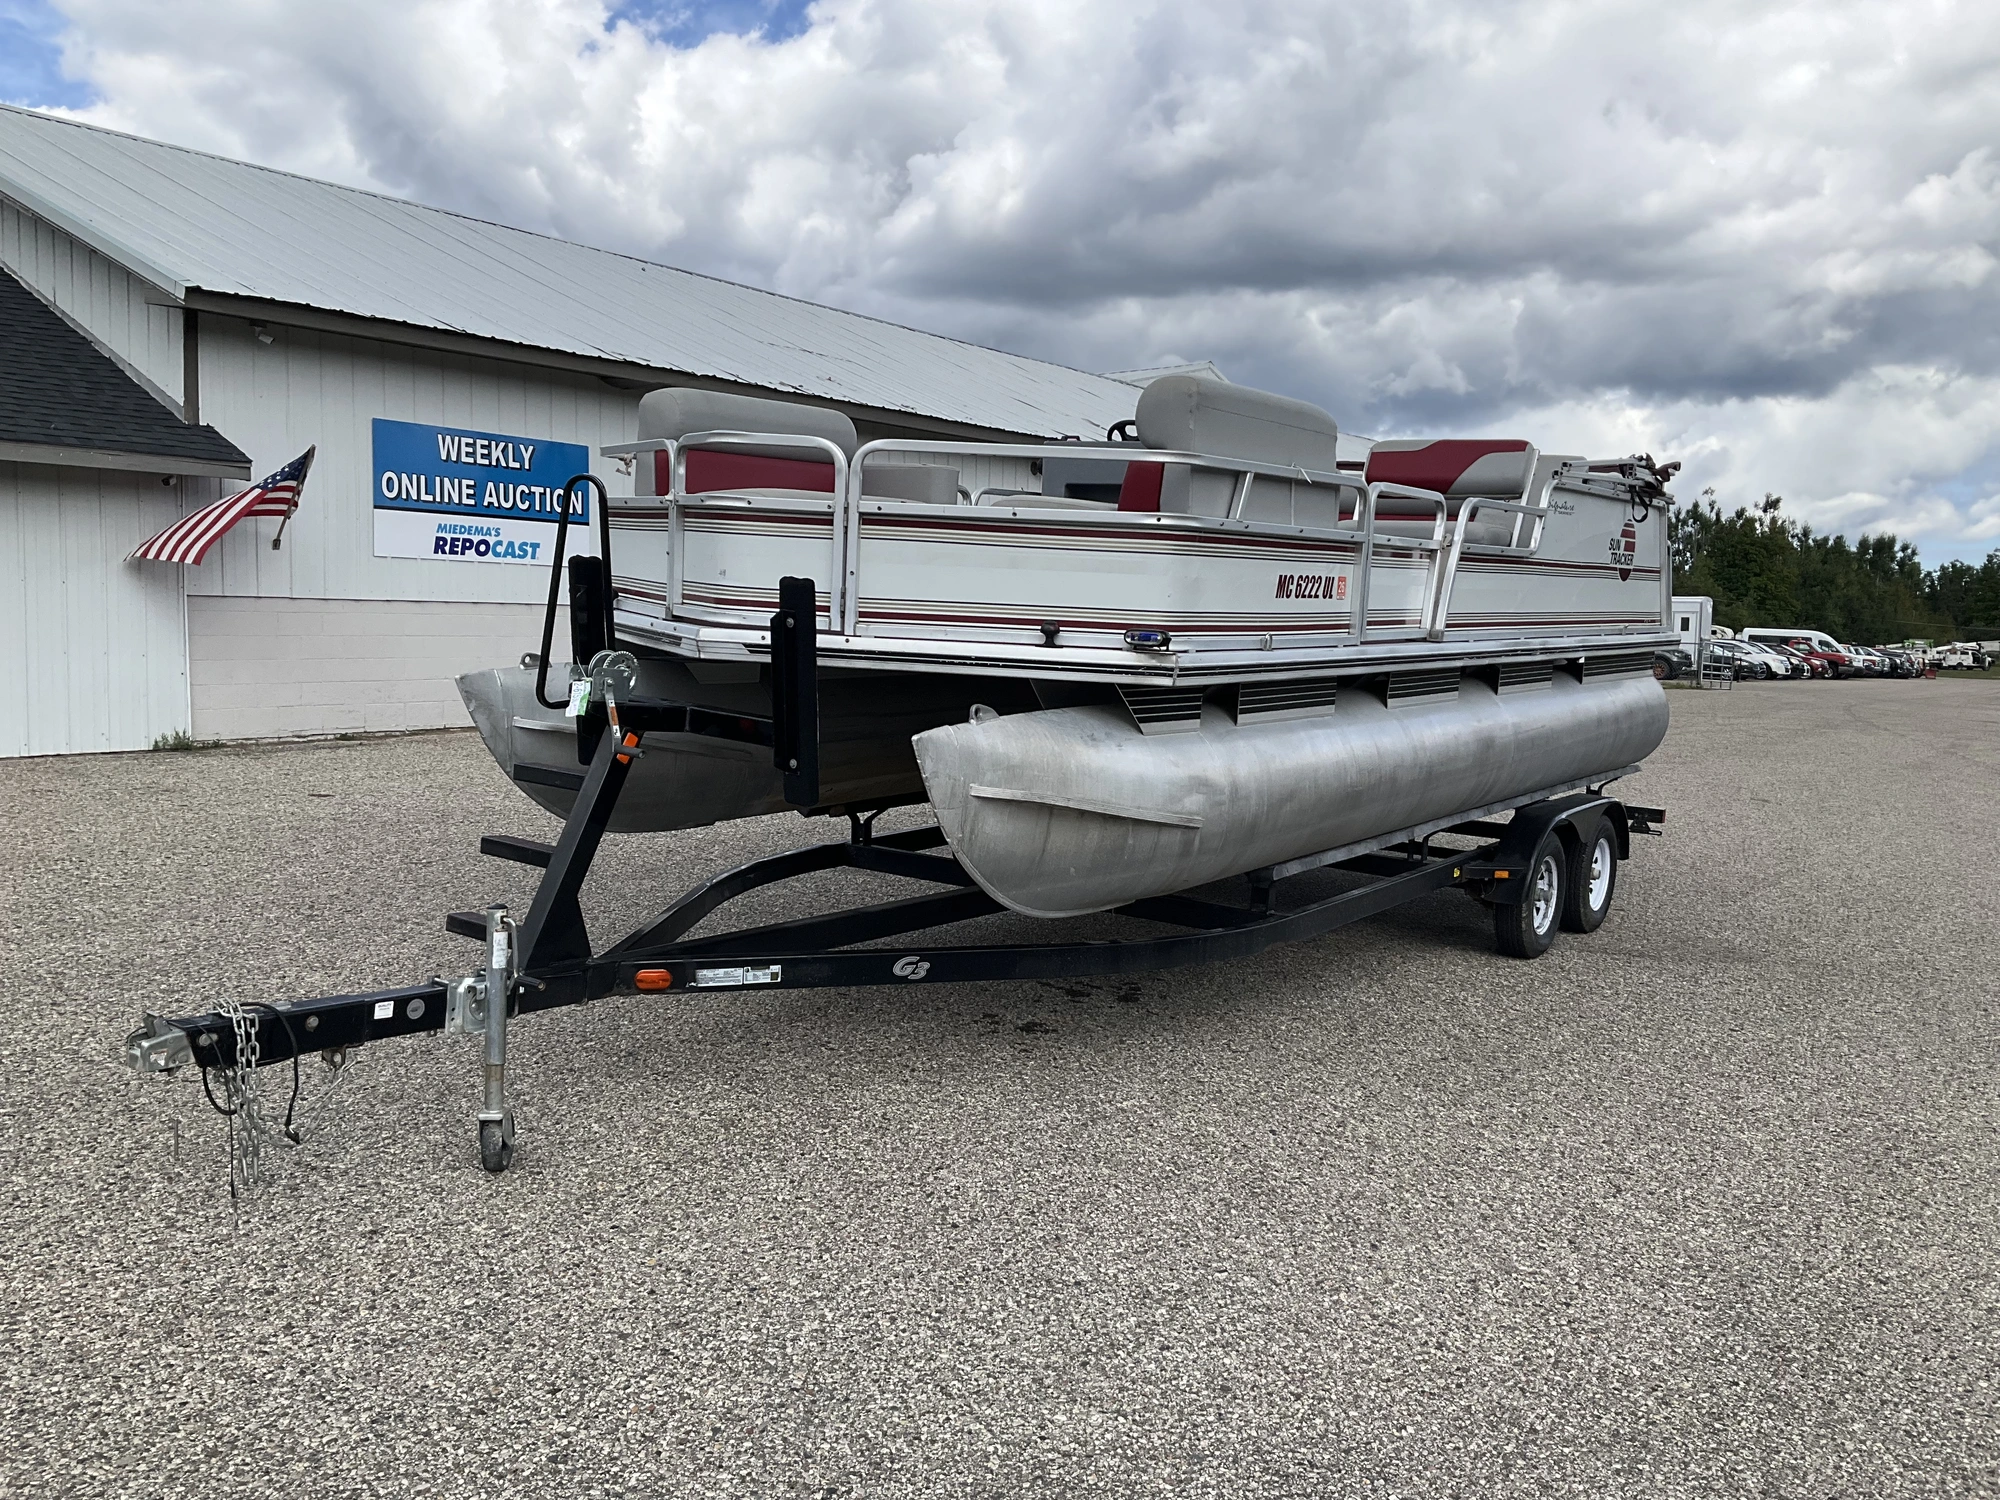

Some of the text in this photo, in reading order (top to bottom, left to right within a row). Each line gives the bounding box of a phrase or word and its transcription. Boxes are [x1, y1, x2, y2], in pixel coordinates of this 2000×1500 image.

[437, 433, 534, 470] WEEKLY
[381, 470, 584, 515] ONLINE AUCTION
[436, 523, 501, 537] MIEDEMA'S
[433, 536, 541, 560] REPOCAST
[1609, 538, 1621, 551] SUN
[1610, 552, 1634, 566] TRACKER
[1275, 574, 1335, 599] MC 6222 UL
[893, 956, 931, 980] G3
